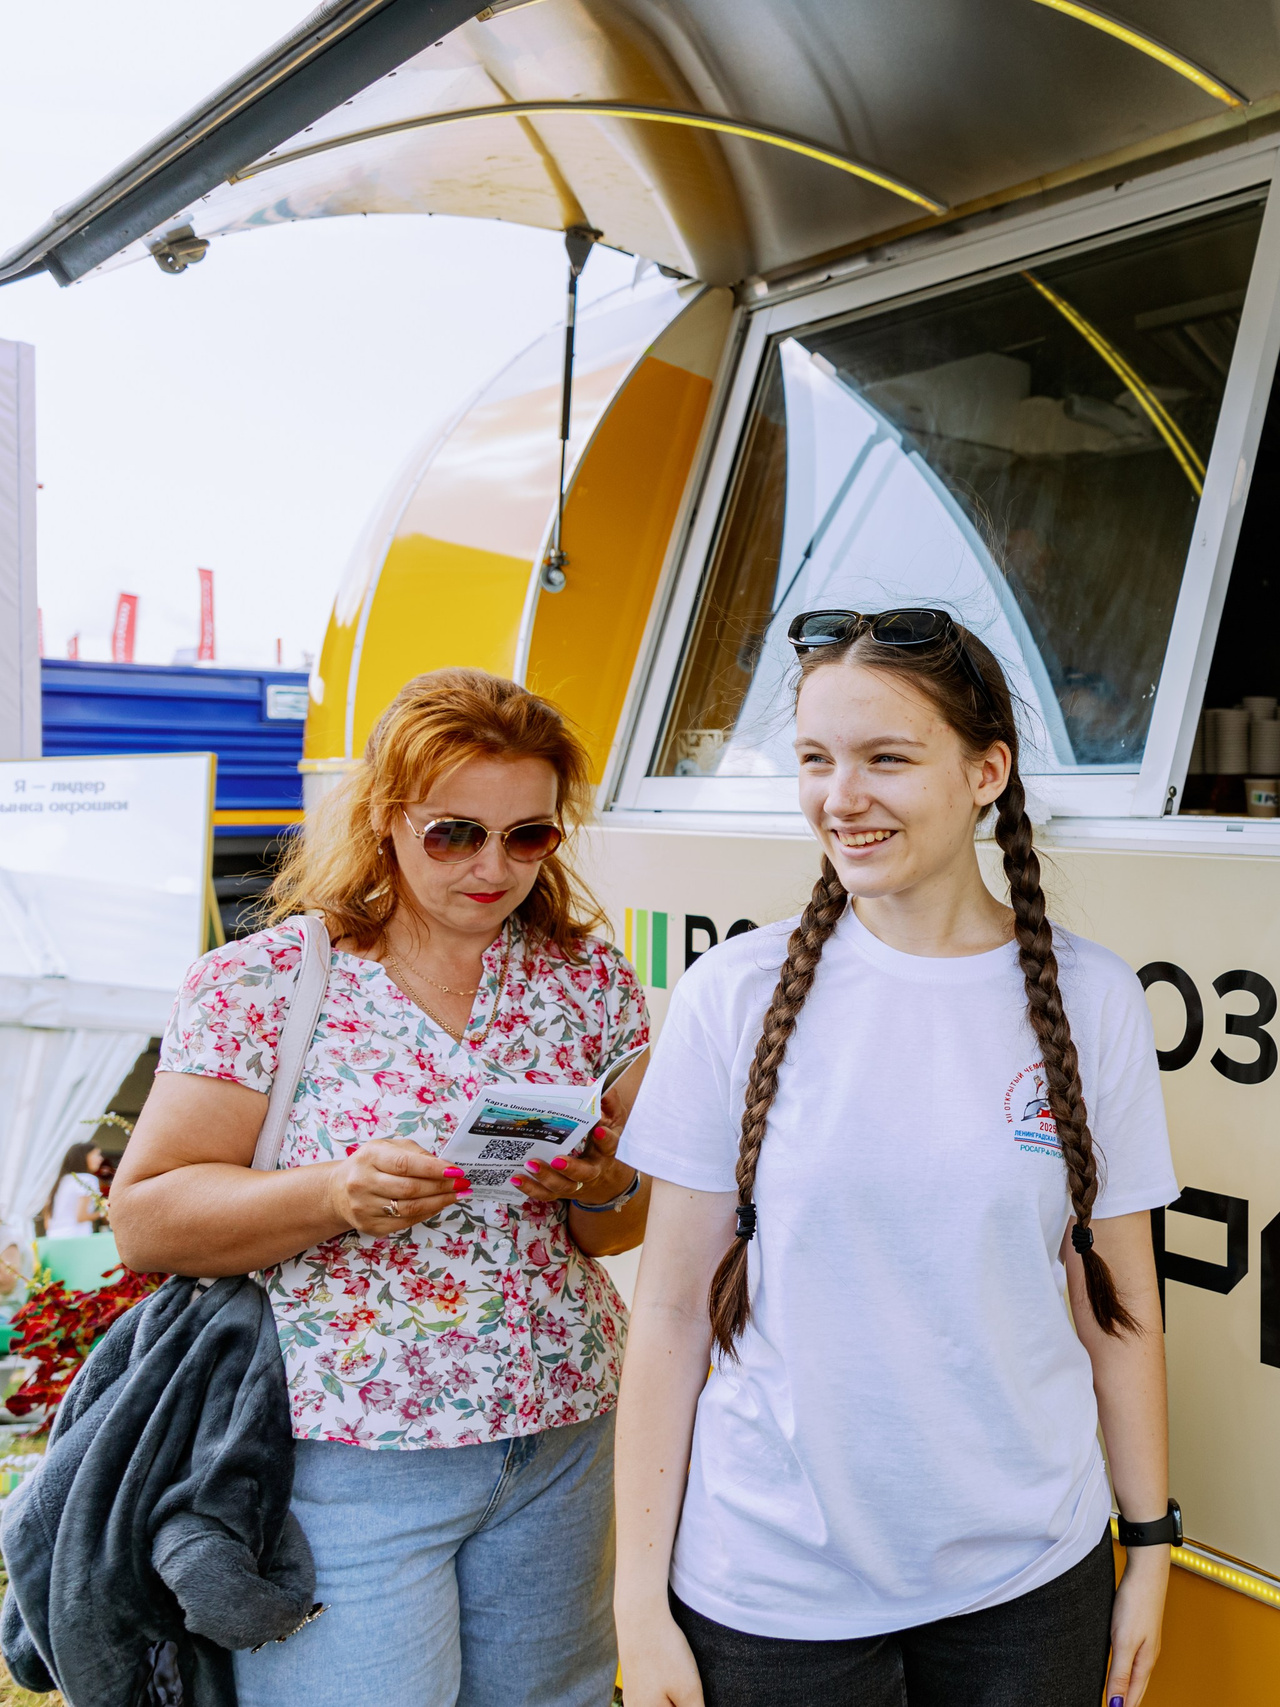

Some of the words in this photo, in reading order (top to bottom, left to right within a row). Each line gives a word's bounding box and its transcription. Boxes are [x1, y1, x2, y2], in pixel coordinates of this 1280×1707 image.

[14, 779, 26, 793] Я
[50, 780, 106, 794] лидер
[0, 802, 43, 813] ынка
[49, 800, 128, 815] окрошки
[1004, 1072, 1024, 1111] ОТКРЫТЫЙ
[484, 1097, 508, 1108] Карта
[510, 1103, 546, 1114] UnionPay
[547, 1109, 590, 1125] бесплатно!
[1040, 1121, 1057, 1134] 2025
[1014, 1129, 1056, 1142] ЛЕНИНГРАДСКАЯ
